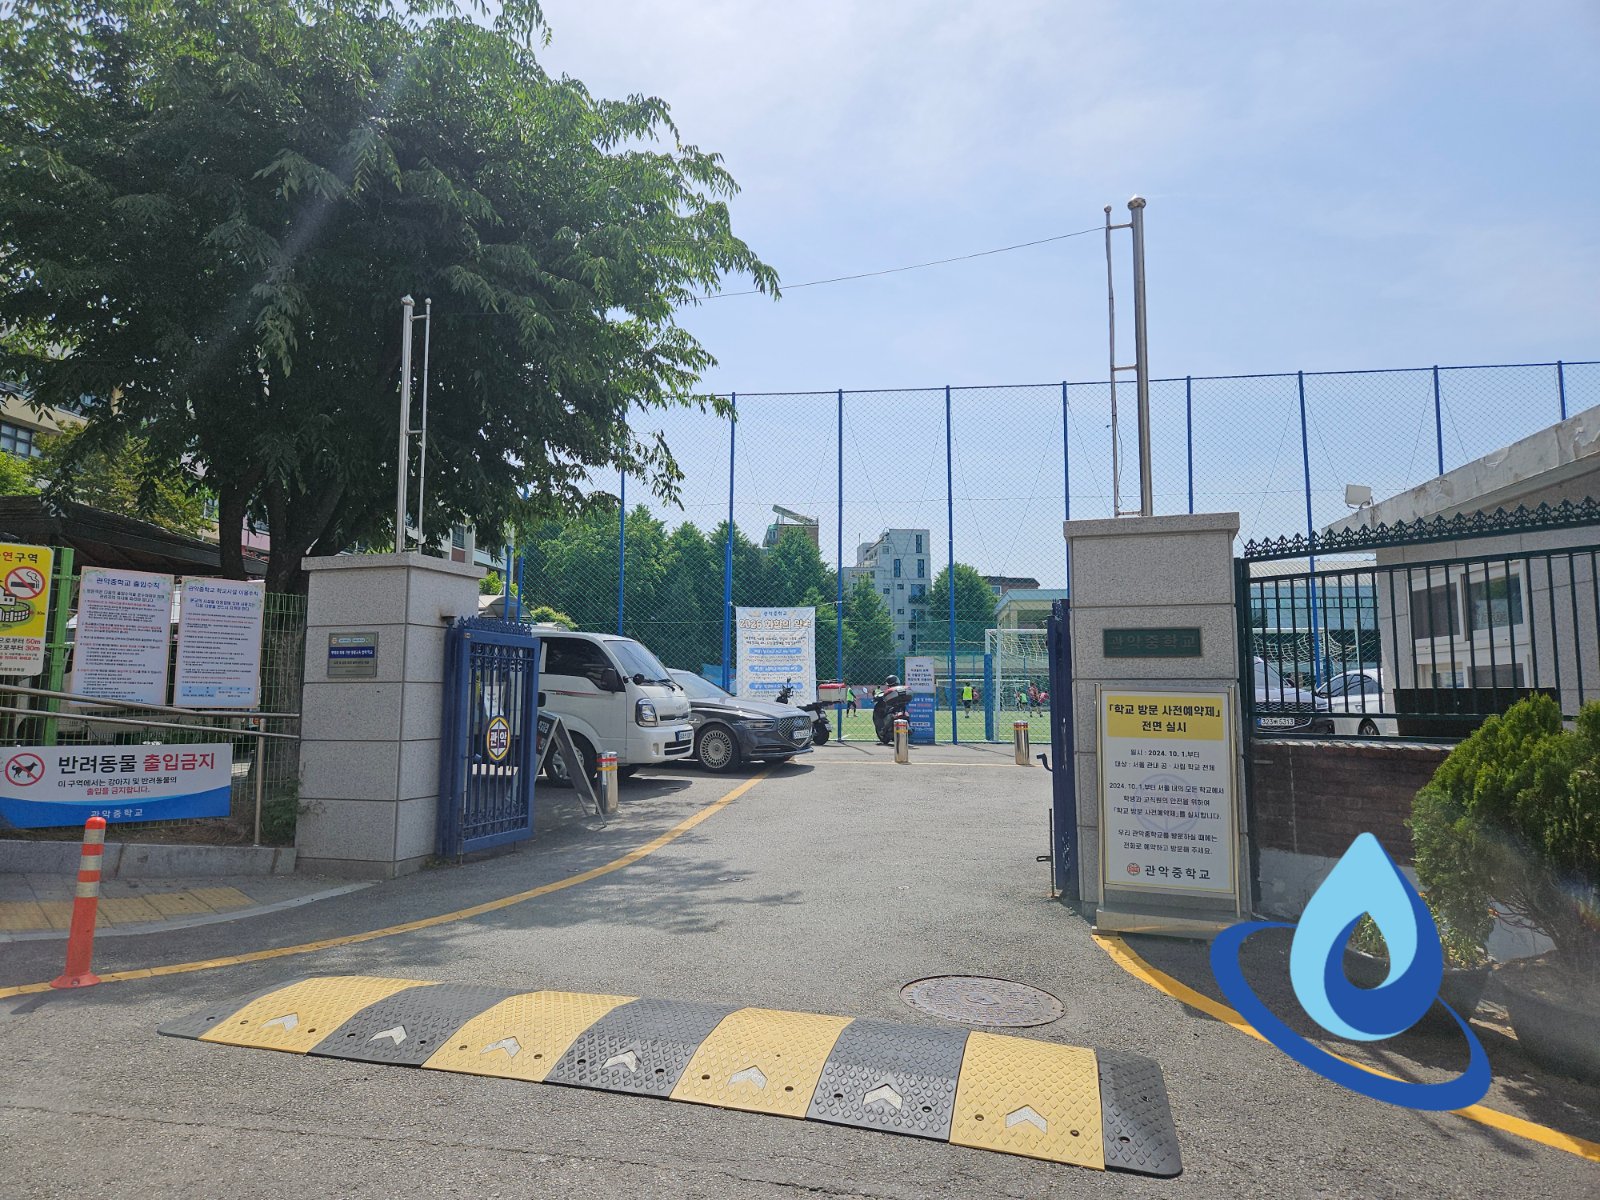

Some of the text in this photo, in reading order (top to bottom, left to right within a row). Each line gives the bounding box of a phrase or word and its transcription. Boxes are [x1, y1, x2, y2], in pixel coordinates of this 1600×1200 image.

[0, 551, 38, 563] 연구역
[96, 577, 160, 589] 관악중학교 출입수칙
[188, 585, 259, 597] 관악중학교 학교시설 이용수칙
[739, 619, 762, 629] 2026
[1111, 634, 1198, 650] 관악중학교
[1138, 704, 1158, 716] 방문
[1142, 720, 1187, 733] 전면 실시
[490, 731, 507, 747] 관악
[1148, 749, 1167, 757] 2024.
[58, 752, 215, 775] 반려동물 출입금지
[1133, 761, 1145, 769] 서울
[1146, 761, 1159, 769] 관내
[1187, 763, 1200, 771] 학교
[57, 775, 177, 788] 이 구역에서는 강아지 및 반려동물의
[86, 785, 151, 796] 출입을 금지합니다.
[1199, 786, 1224, 794] 학교에서
[1123, 795, 1210, 806] 학생과 교직원의 안전을 위하여
[90, 808, 144, 818] 관악중학교
[1132, 829, 1169, 839] 관악중학교를
[1171, 832, 1196, 841] 방문하실
[1123, 842, 1213, 855] 전화로 예약하고 방문해 주세요.
[1144, 865, 1211, 880] 관악중학교
